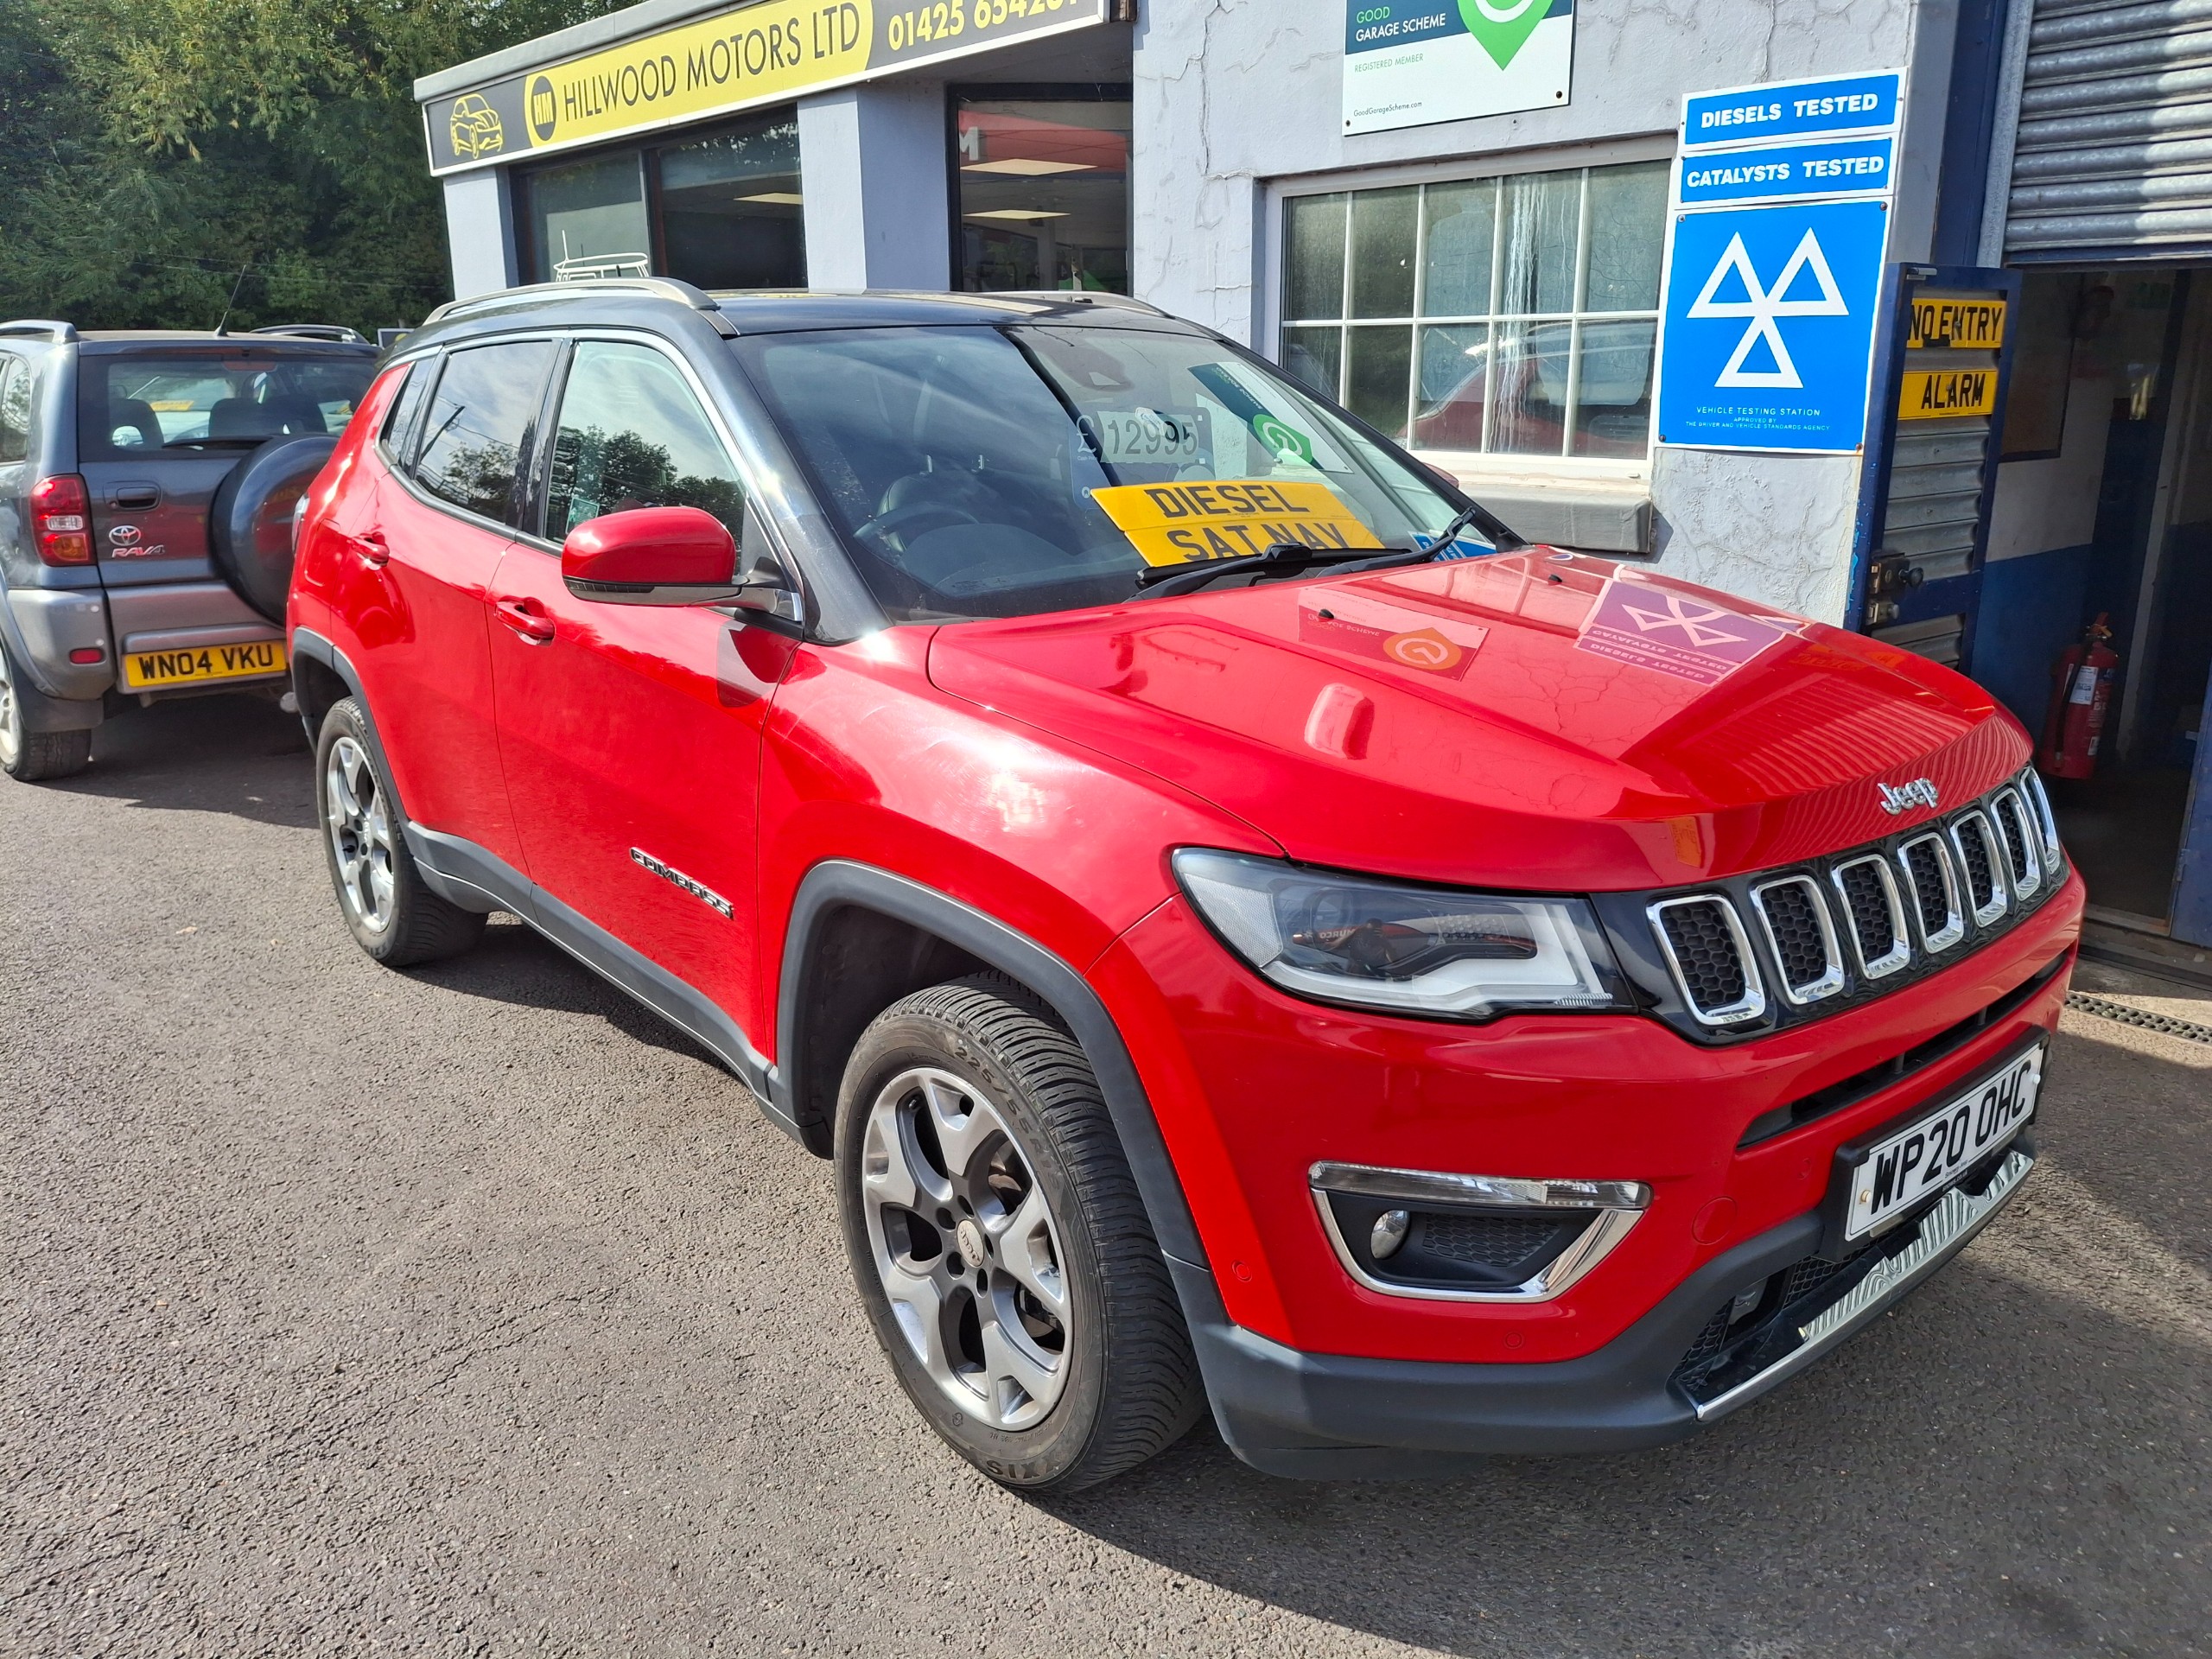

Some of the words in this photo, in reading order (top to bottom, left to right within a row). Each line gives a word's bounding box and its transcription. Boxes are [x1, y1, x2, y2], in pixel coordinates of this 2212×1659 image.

[888, 0, 965, 51] 01425
[1355, 18, 1400, 42] GARAGE
[1402, 13, 1446, 35] SCHEME
[1356, 6, 1390, 24] GOOD
[563, 54, 677, 122] HILLWOOD
[687, 17, 802, 92] MOTORS
[812, 2, 860, 60] LTD
[1354, 58, 1393, 73] REGISTERED
[1394, 54, 1424, 67] MEMBER
[533, 91, 554, 126] HM
[1353, 100, 1423, 118] GoodGarageScheme.com
[1700, 103, 1782, 129] DIESELS
[1793, 92, 1879, 118] TESTED
[1686, 162, 1790, 188] CATALYSTS
[1802, 155, 1885, 178] TESTED
[1907, 304, 1936, 341] NO
[1938, 305, 2003, 341] ENTRY
[1920, 372, 1986, 410] ALARM
[1696, 406, 1734, 415] VEHICLE
[1737, 407, 1777, 416] TESTING
[1780, 408, 1821, 416] STATION
[1107, 418, 1198, 456] 12995
[1143, 484, 1311, 518] DIESEL
[111, 544, 165, 558] RAV4
[1166, 524, 1262, 562] SAT
[1260, 522, 1350, 550] NAV
[137, 650, 213, 680] WN04
[220, 644, 274, 671] VKU
[1877, 777, 1938, 816] Jeep
[629, 846, 734, 920] COMPASS
[1870, 1104, 1971, 1216] WP20
[1974, 1059, 2032, 1148] OHC
